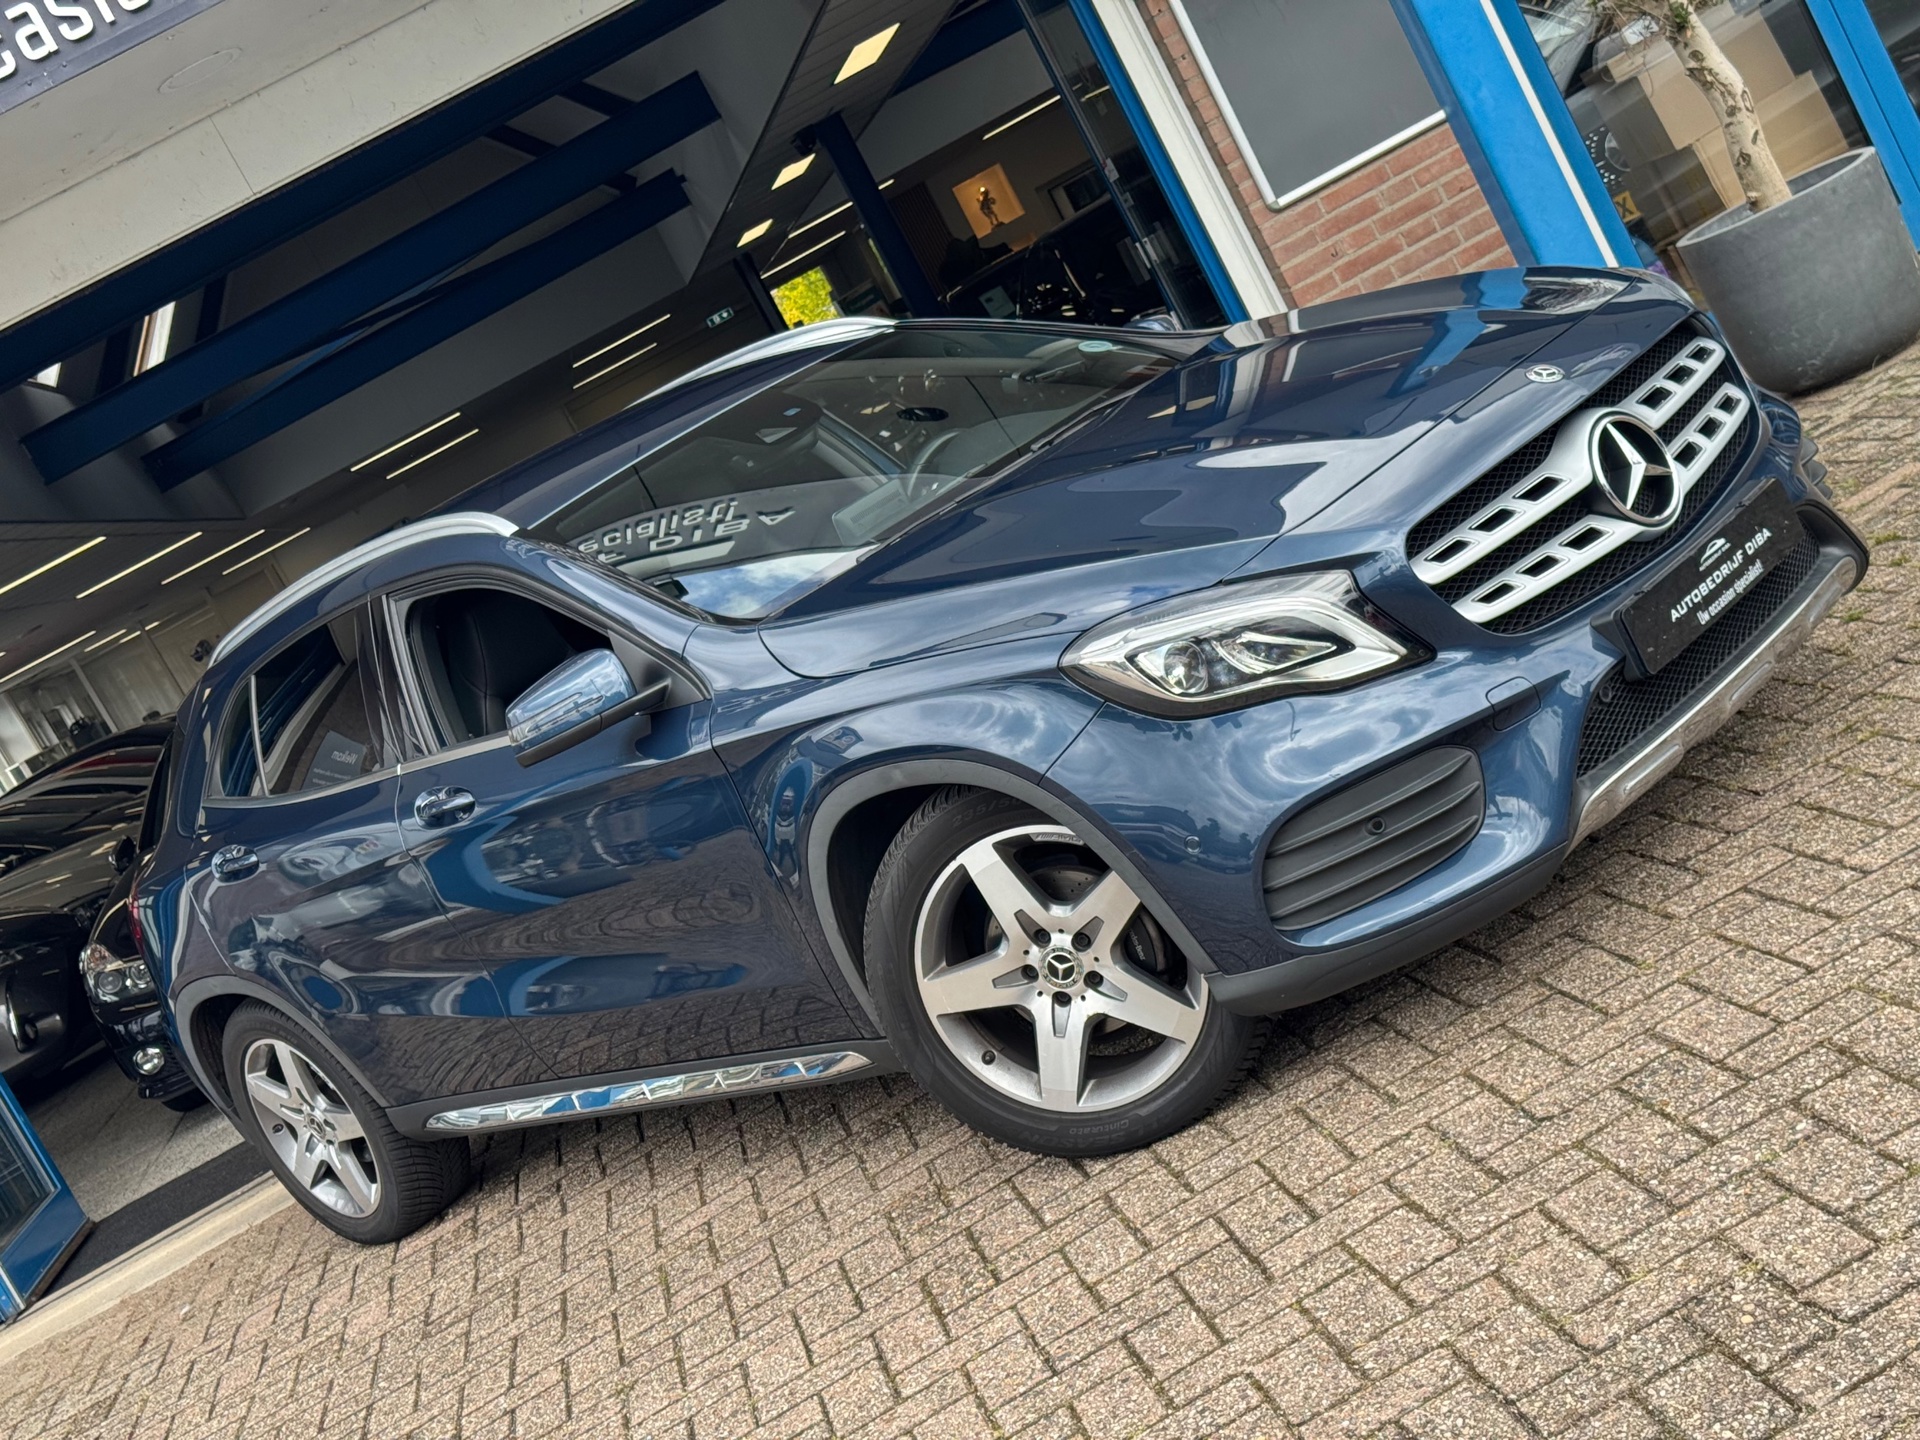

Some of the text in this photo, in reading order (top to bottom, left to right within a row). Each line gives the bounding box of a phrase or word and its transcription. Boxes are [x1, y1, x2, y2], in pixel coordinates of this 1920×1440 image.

[1670, 528, 1772, 623] AUTOBEDRIJF DIBA
[1696, 559, 1764, 625] Uw occasion specialist!
